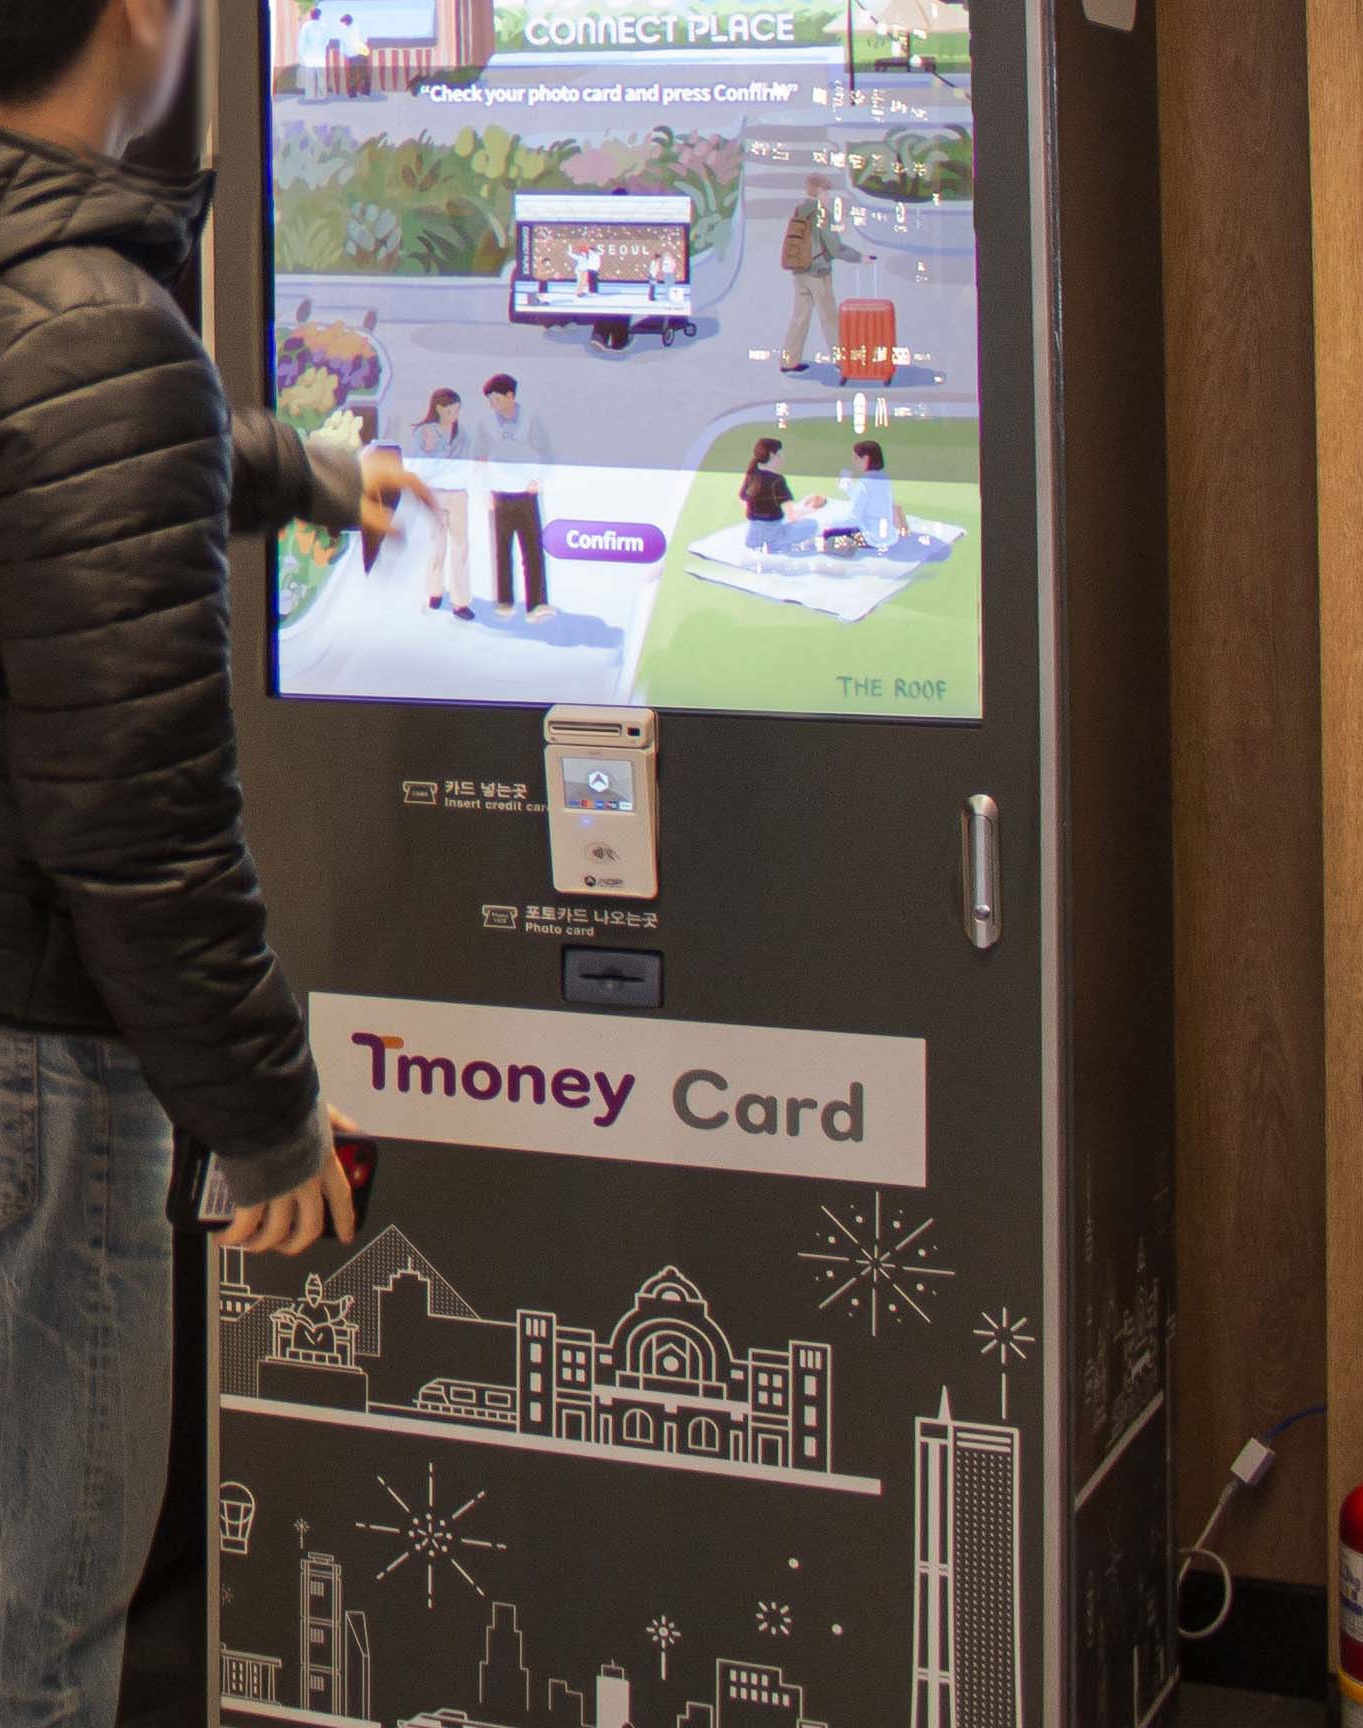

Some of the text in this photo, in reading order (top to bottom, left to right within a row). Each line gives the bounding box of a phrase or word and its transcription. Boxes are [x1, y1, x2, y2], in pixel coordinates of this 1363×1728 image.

[688, 12, 795, 43] PLACE
[484, 87, 525, 106] your
[528, 83, 579, 105] photo
[582, 83, 621, 103] card
[625, 83, 660, 102] and
[663, 86, 712, 106] press
[597, 243, 650, 256] SEOUL
[565, 526, 645, 553] Confirm
[837, 675, 948, 701] THE ROOF
[444, 780, 527, 800] 카드 넣는곳
[444, 798, 549, 813] Insert credit car
[525, 905, 589, 923] 포토카드
[593, 908, 658, 929] 나오는곳
[525, 922, 594, 936] Photo card
[351, 1030, 865, 1145] Tmoney Card
